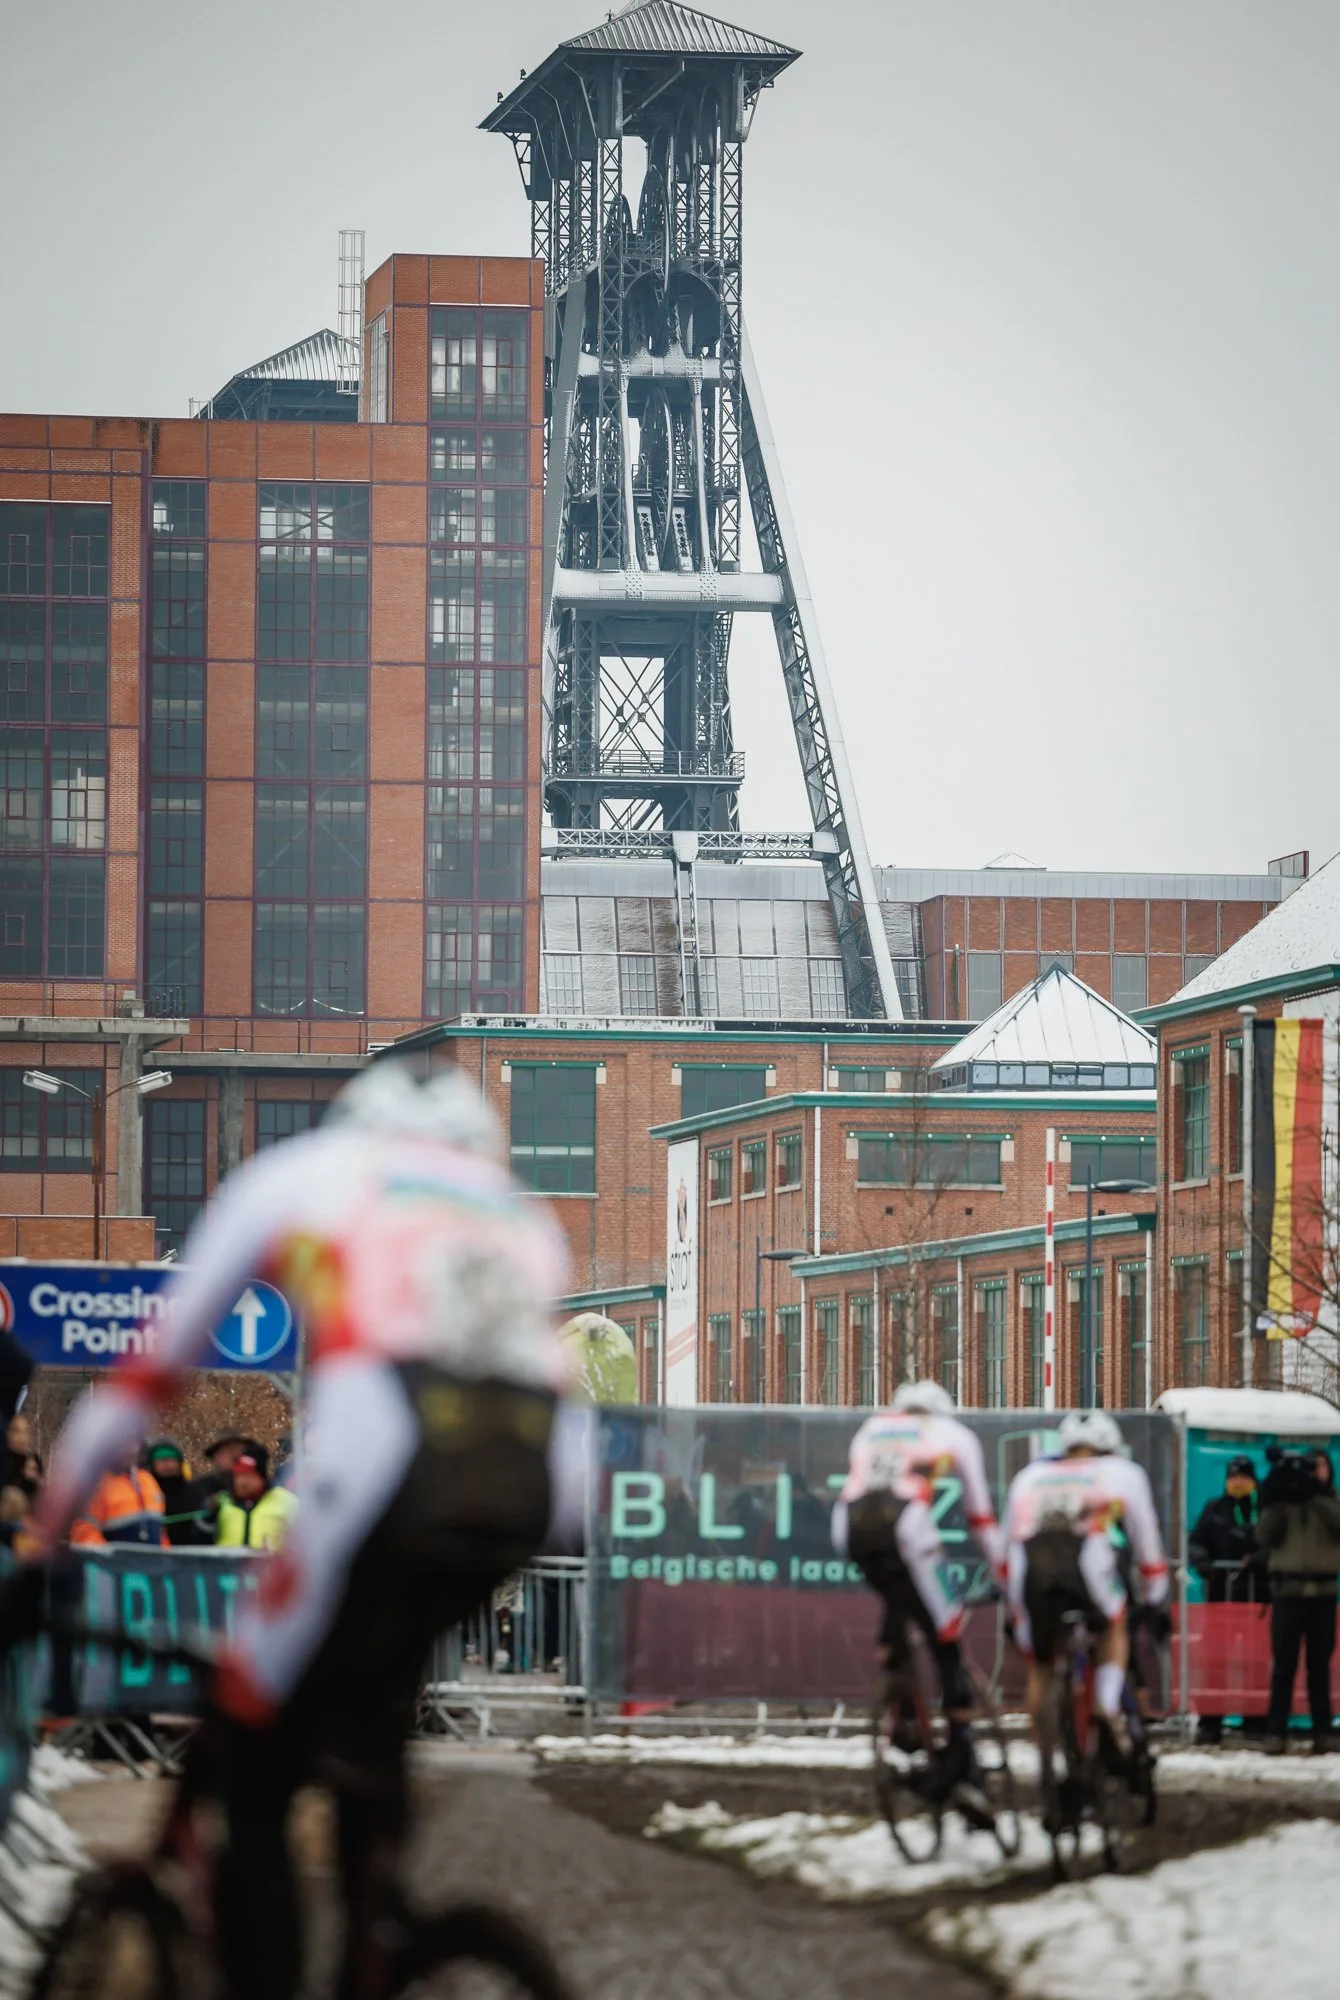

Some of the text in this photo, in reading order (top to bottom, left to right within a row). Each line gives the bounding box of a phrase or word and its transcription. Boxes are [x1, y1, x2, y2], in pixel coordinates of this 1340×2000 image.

[29, 1282, 182, 1320] Crossin
[62, 1318, 158, 1354] Point
[610, 1553, 778, 1586] Belgische
